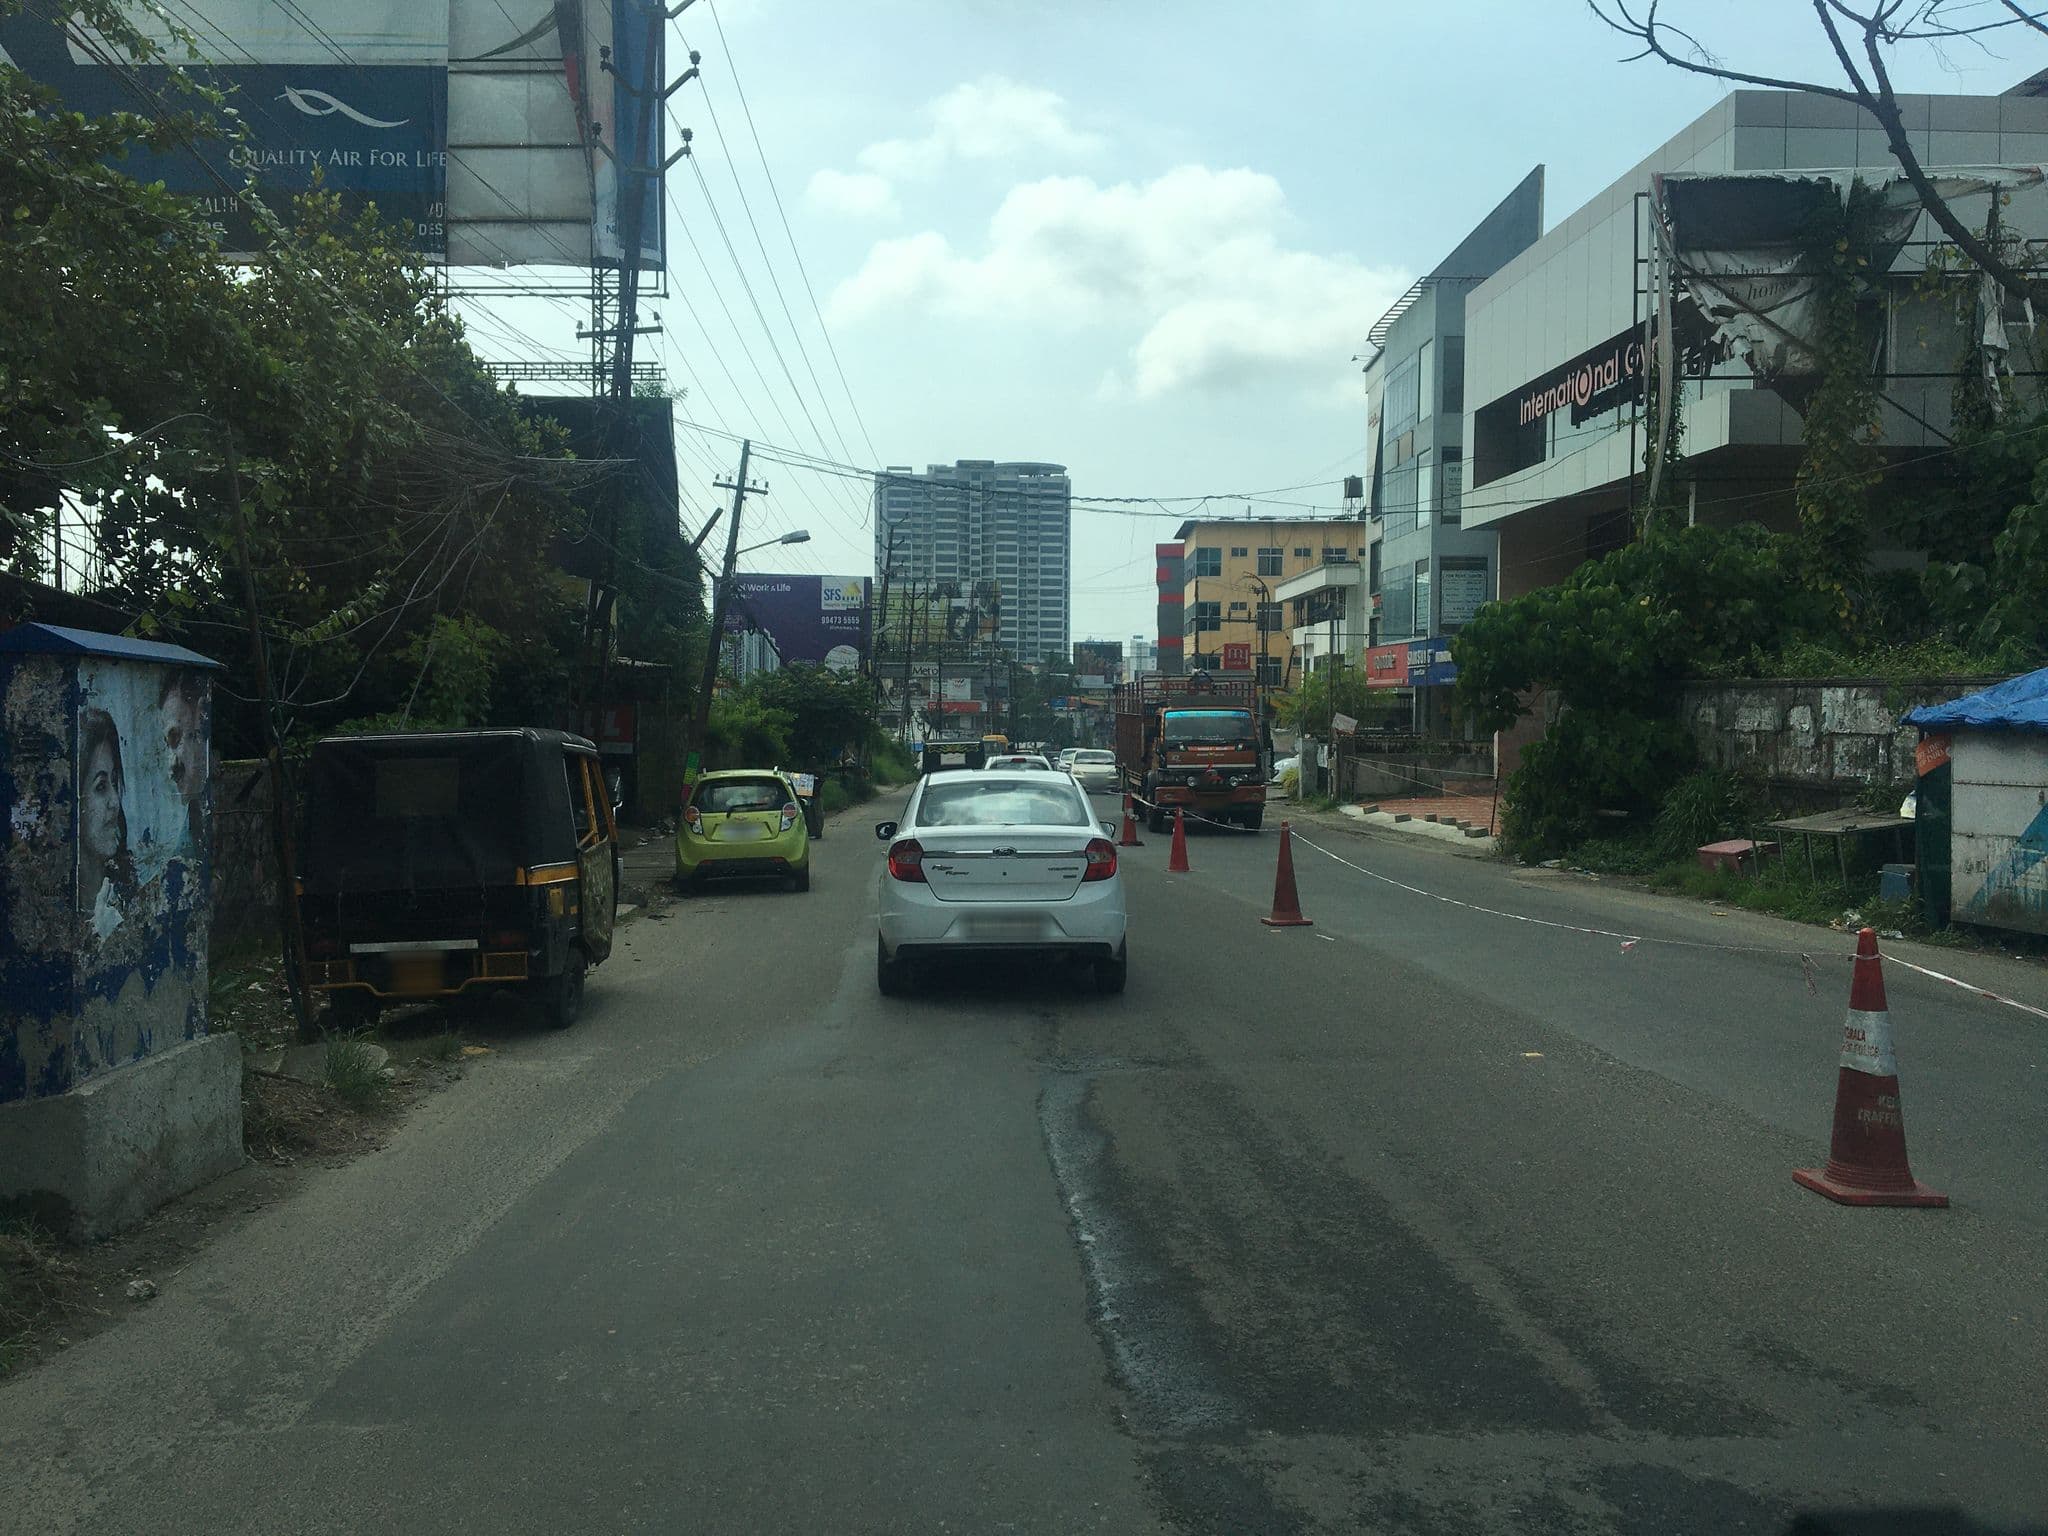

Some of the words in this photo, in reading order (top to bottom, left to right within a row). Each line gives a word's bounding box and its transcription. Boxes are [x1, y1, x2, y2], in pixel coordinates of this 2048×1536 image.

[329, 148, 362, 166] AIR
[370, 149, 408, 167] FOR
[416, 150, 447, 167] LIFE
[747, 583, 770, 592] Work
[777, 583, 792, 592] Life
[824, 589, 841, 600] SFS
